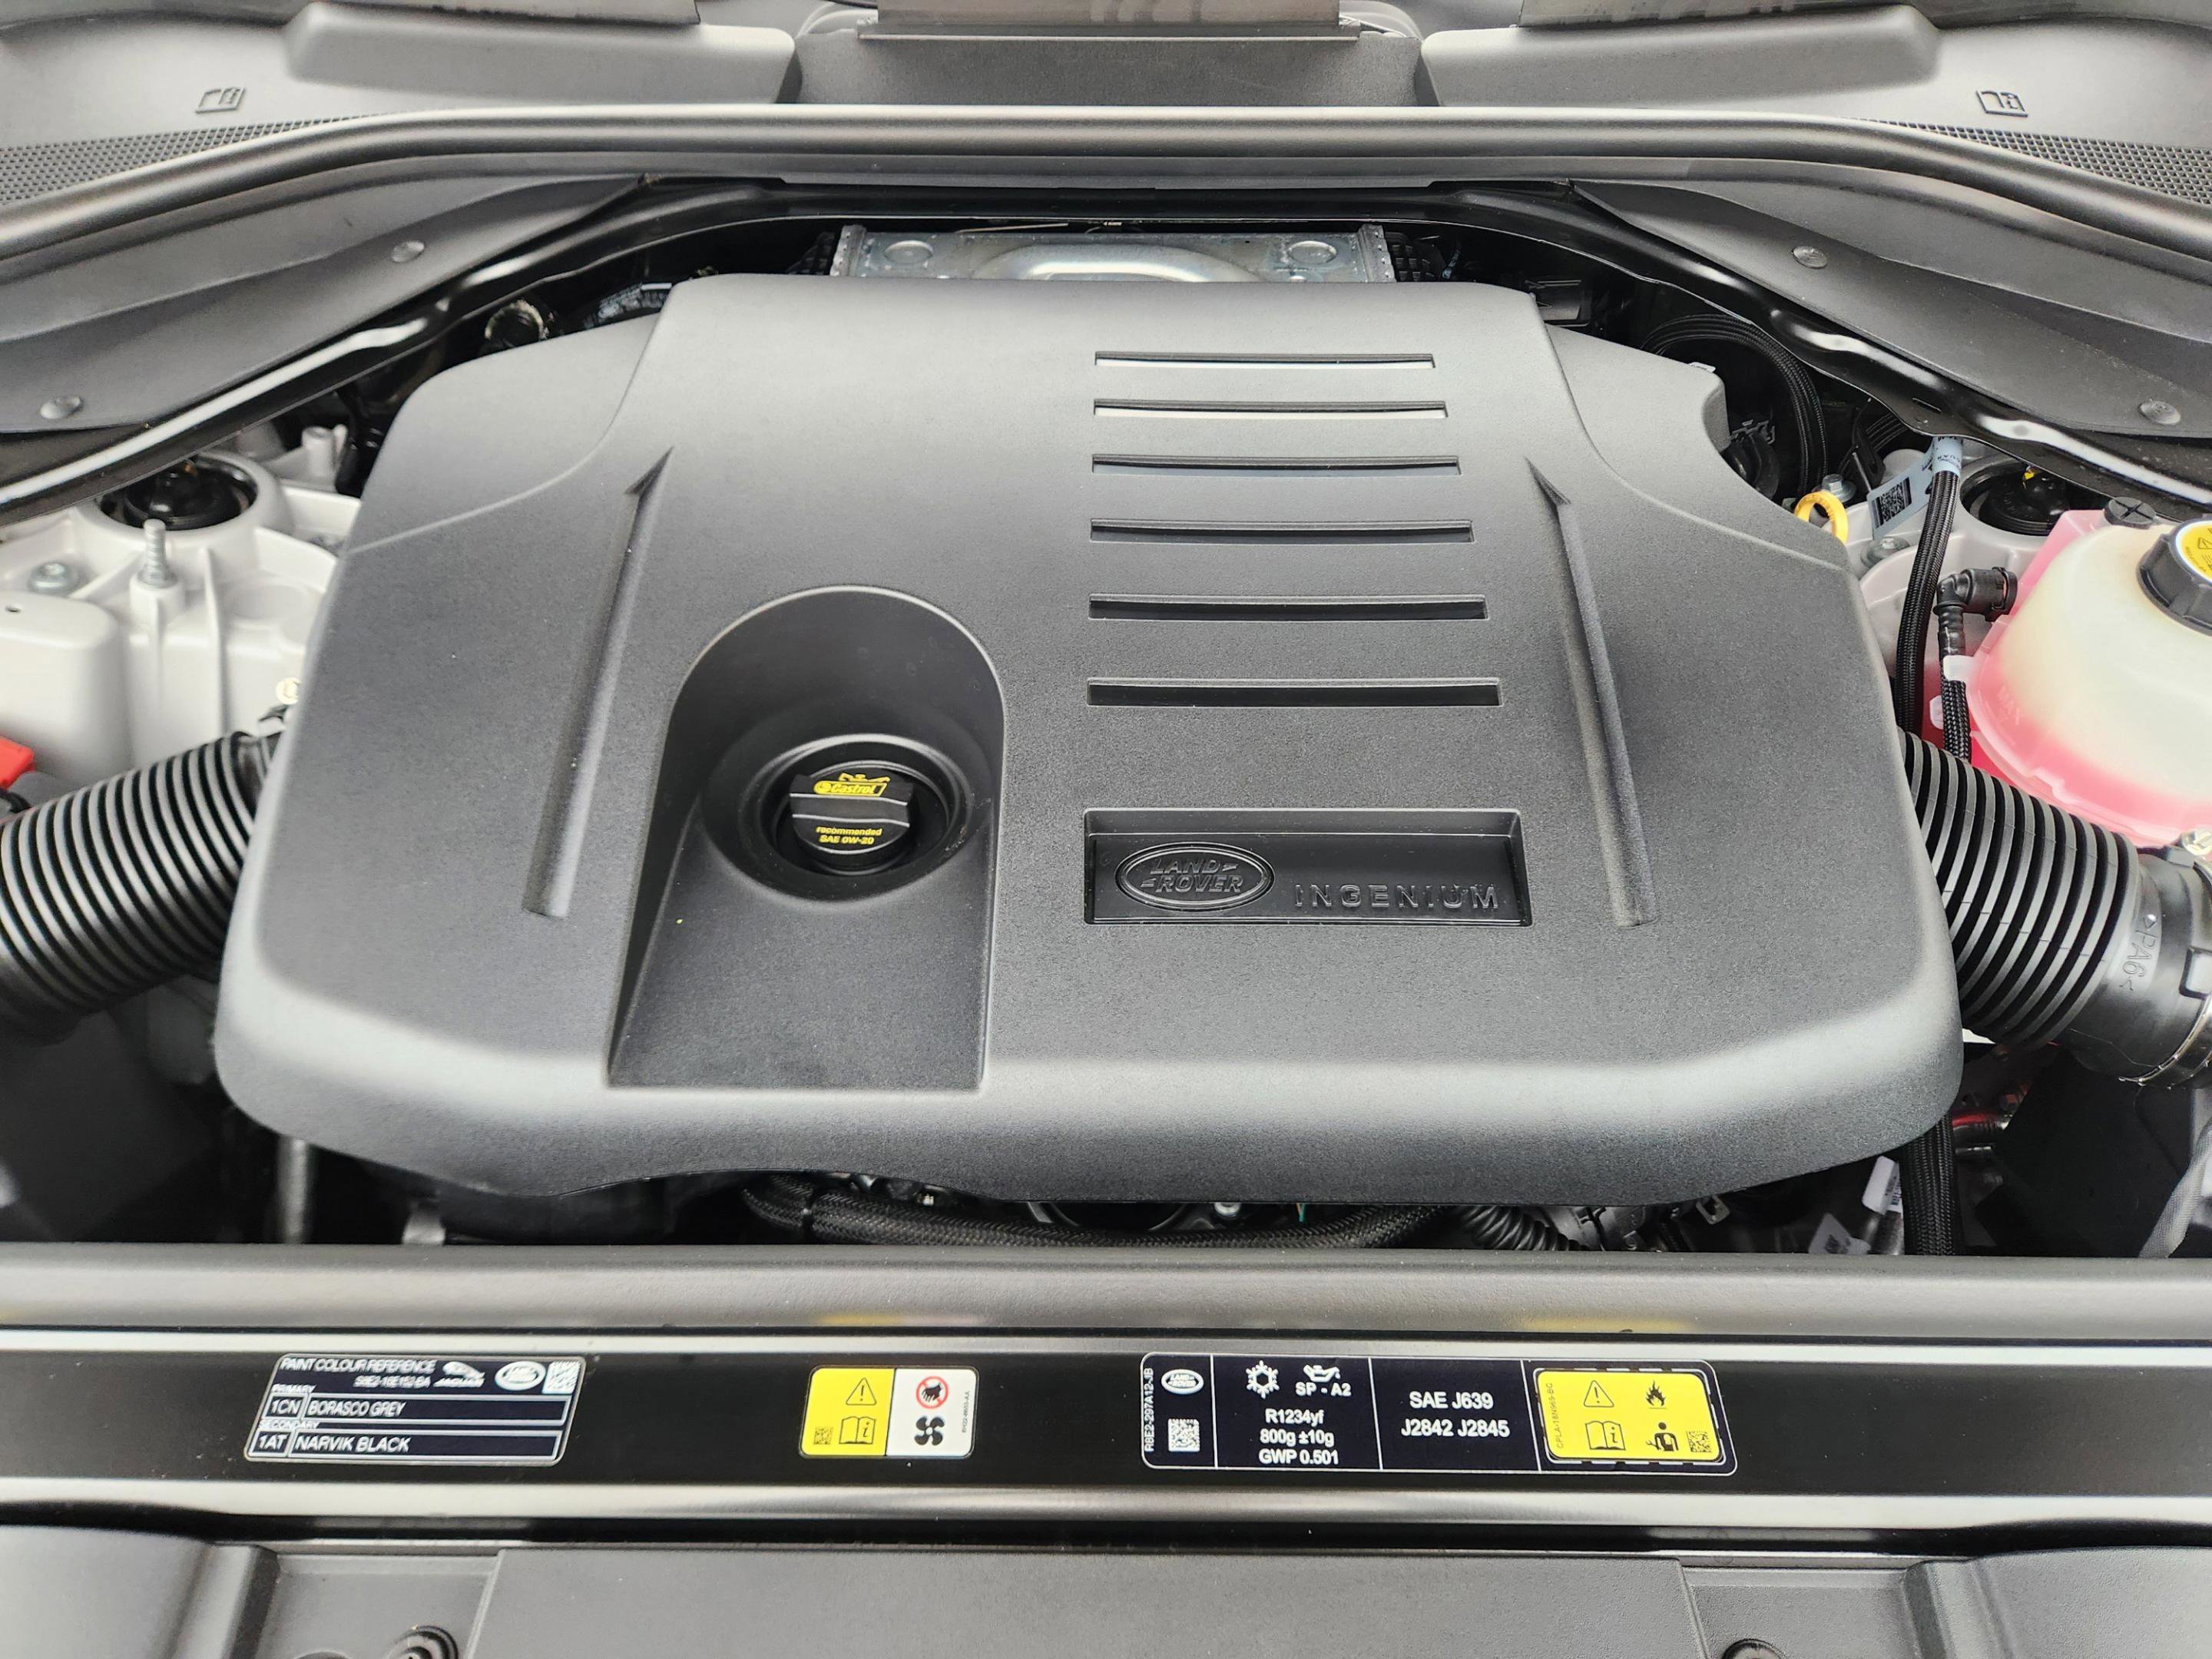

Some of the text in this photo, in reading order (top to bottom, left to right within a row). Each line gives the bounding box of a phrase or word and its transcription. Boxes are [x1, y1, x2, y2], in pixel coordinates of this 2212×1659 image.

[830, 783, 877, 794] Castrol
[816, 826, 882, 836] recommended
[819, 834, 875, 845] SAE 0W-20
[1150, 858, 1216, 876] LAND
[1155, 874, 1244, 893] ROVER
[1294, 884, 1498, 910] INGENIUM
[280, 1358, 437, 1374] PAINT COLOUR REFERENCE
[1295, 1382, 1316, 1396] SP
[1331, 1382, 1352, 1397] A2
[270, 1399, 407, 1417] 1CN BORASCO GREY
[1409, 1391, 1494, 1410] SAE J639
[1265, 1408, 1325, 1427] R1234yf
[1401, 1418, 1511, 1438] J2842 J2845
[258, 1434, 412, 1452] 1AT NARVIK BLACK
[1260, 1429, 1335, 1448] 800g ±10g
[1258, 1449, 1339, 1465] GWP 0.501
